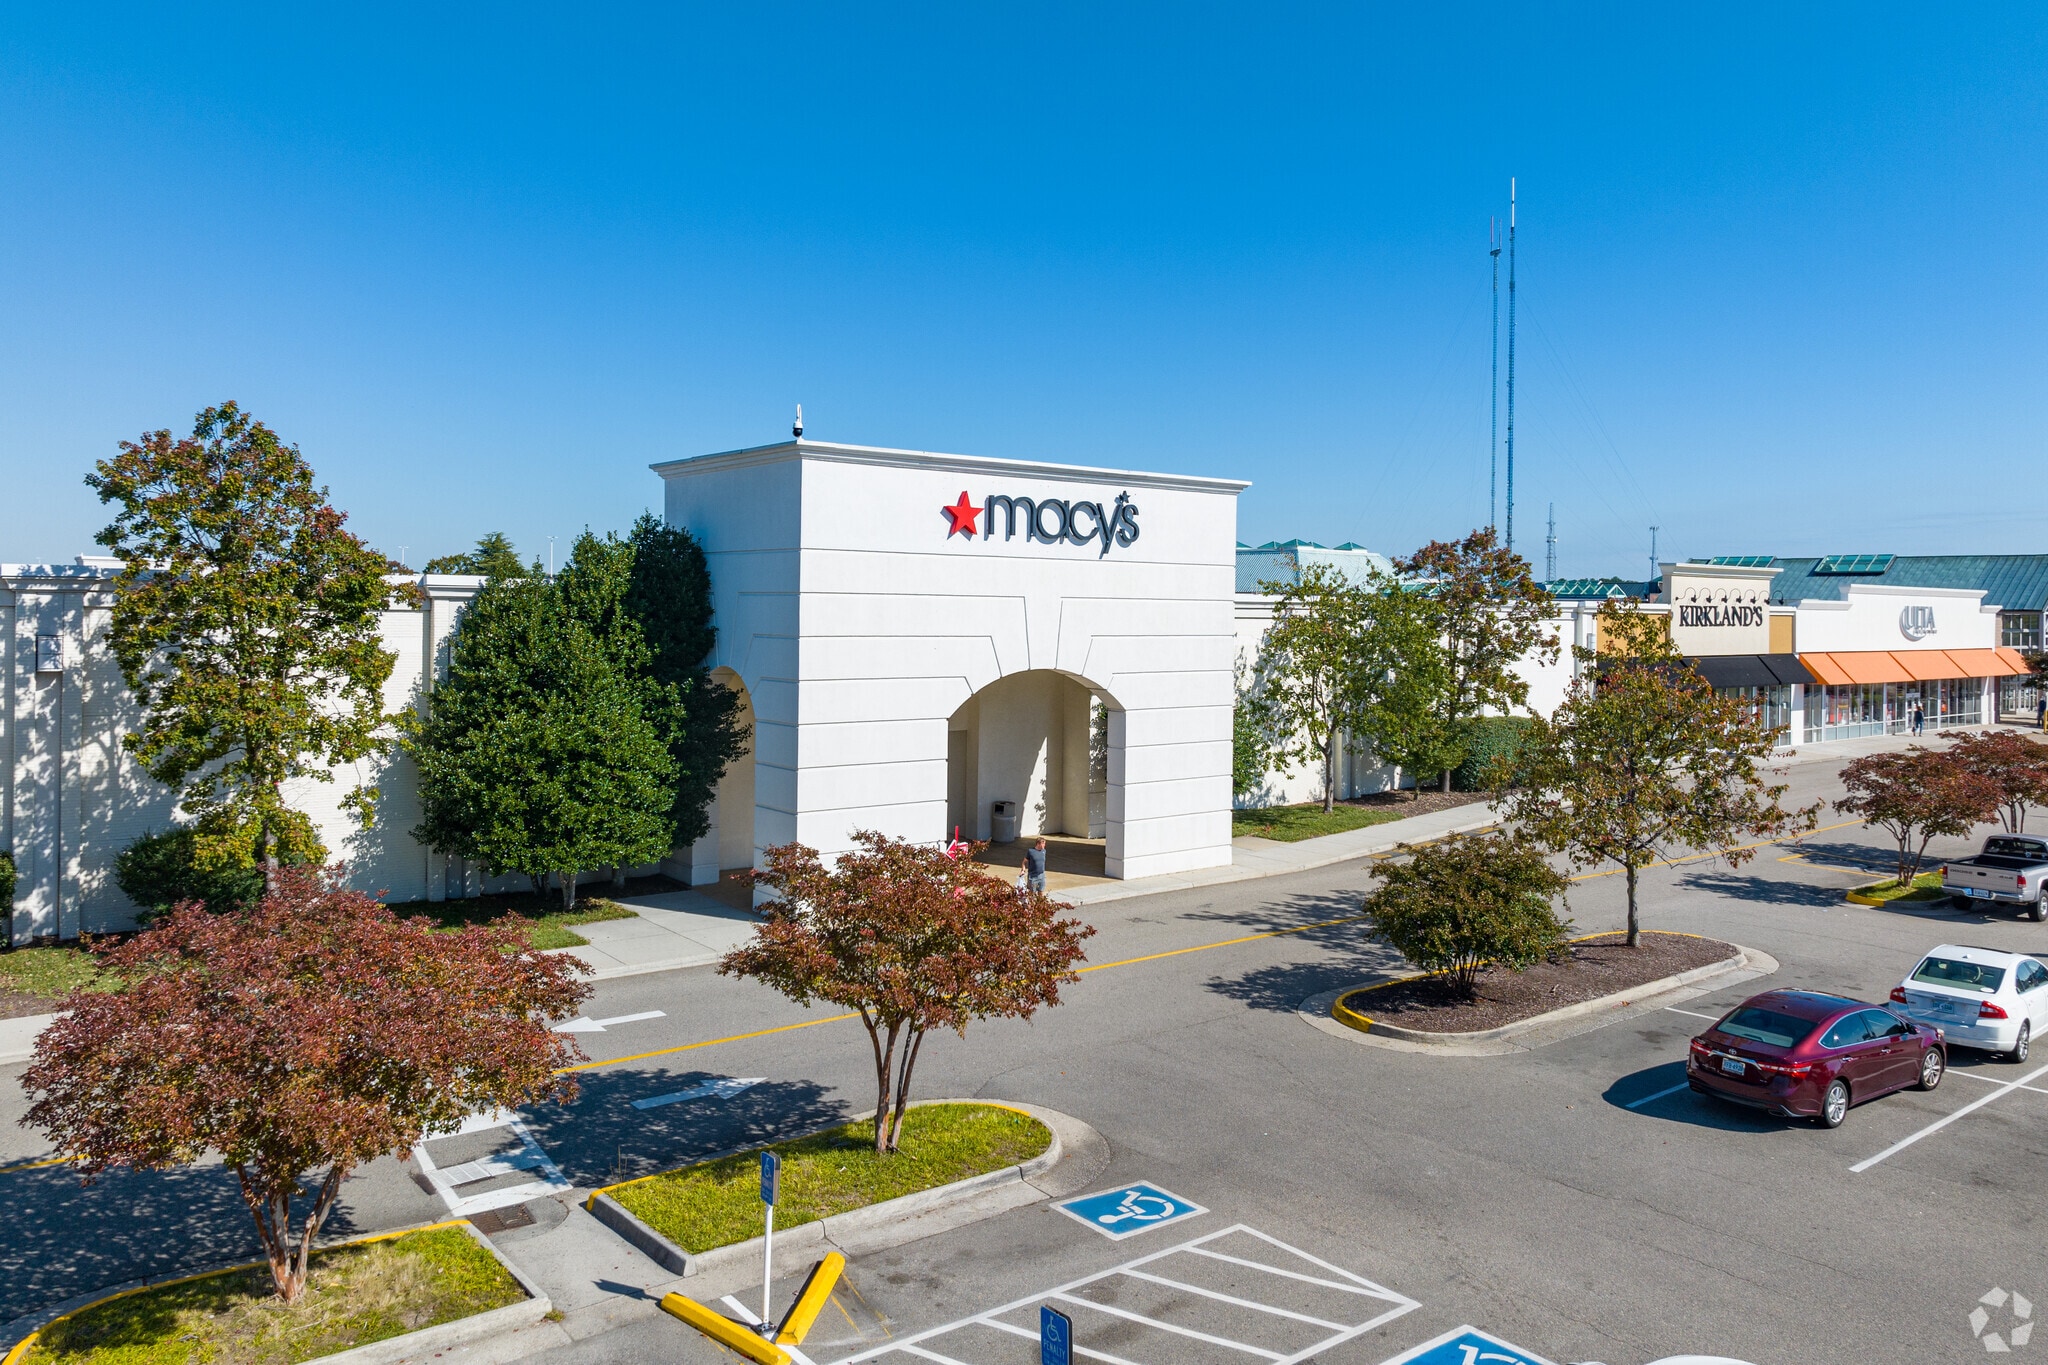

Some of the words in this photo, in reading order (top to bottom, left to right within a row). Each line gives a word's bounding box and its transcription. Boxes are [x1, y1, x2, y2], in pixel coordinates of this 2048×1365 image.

[984, 491, 1140, 559] macy's
[1679, 605, 1763, 627] KIRKLAND'S
[1904, 605, 1936, 630] ULTA
[1043, 1338, 1066, 1360] PENALTY
